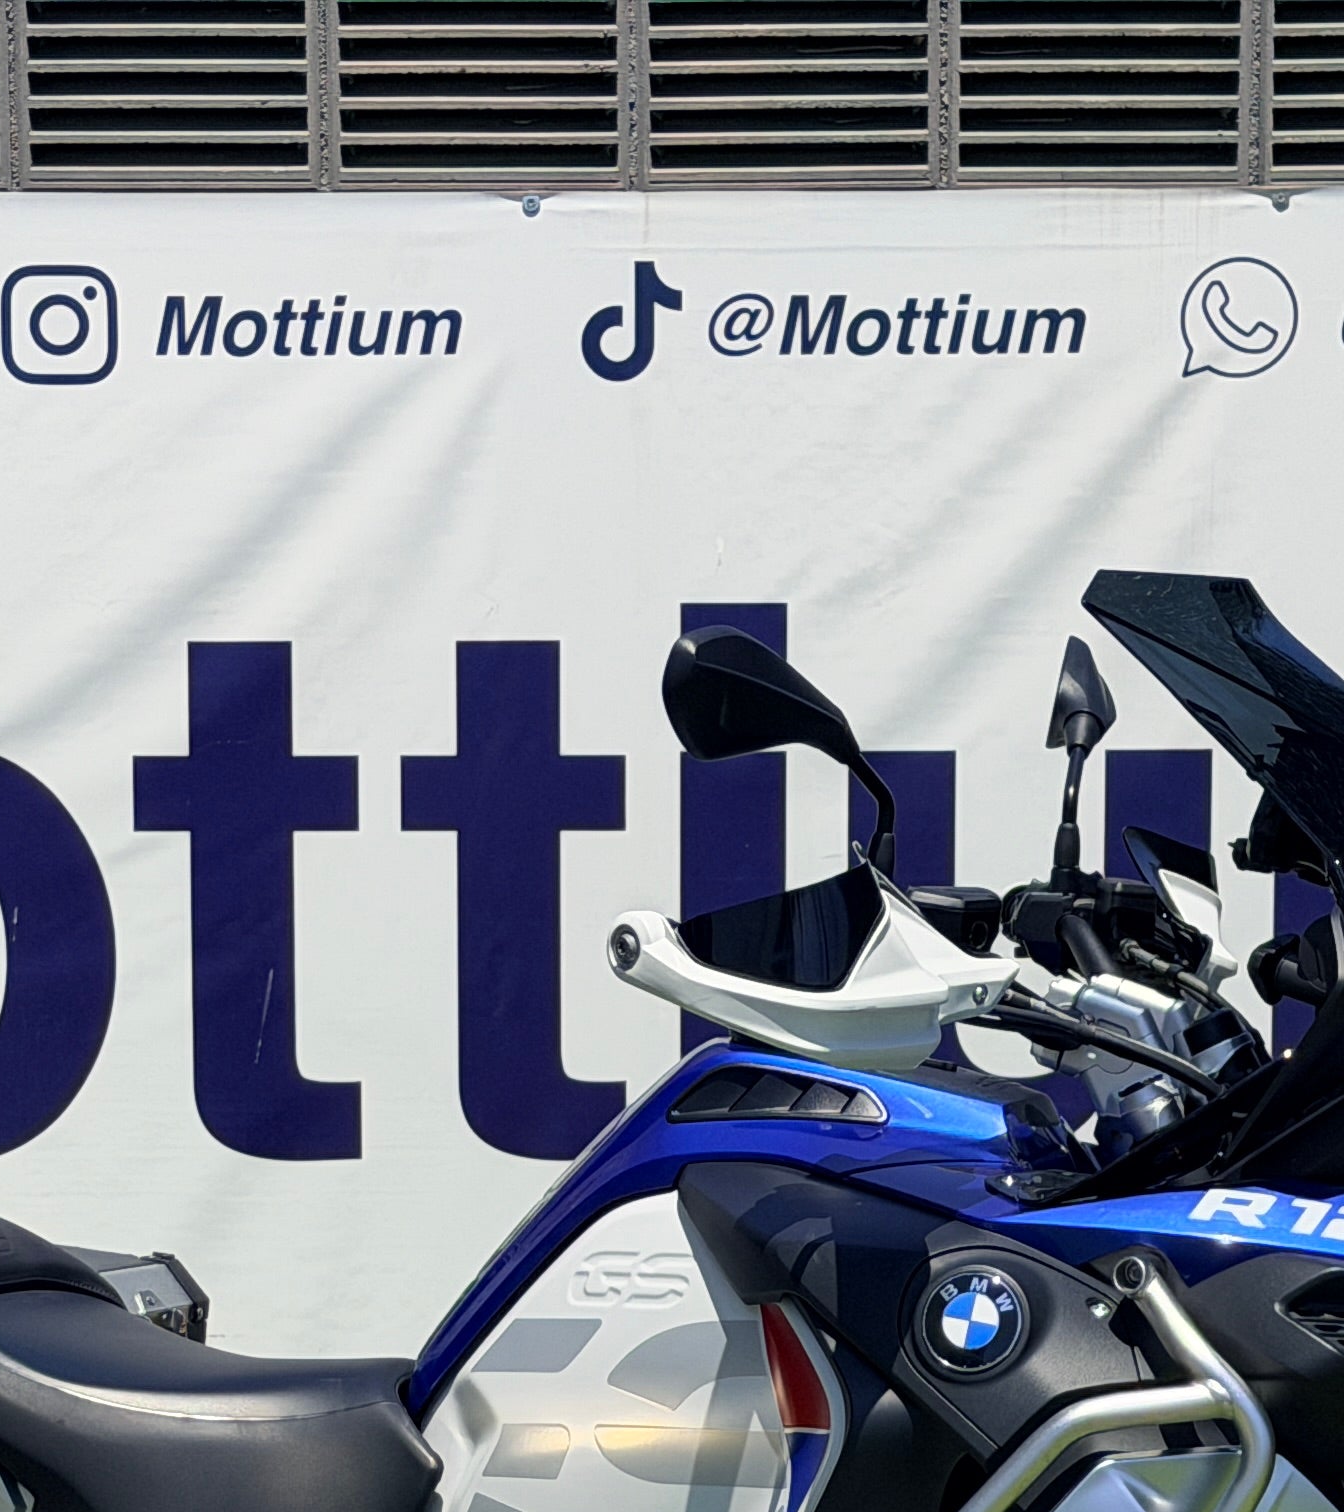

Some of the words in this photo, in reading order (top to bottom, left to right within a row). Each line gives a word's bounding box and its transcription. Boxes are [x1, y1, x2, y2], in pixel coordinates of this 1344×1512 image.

[157, 296, 462, 357] Mottium
[709, 294, 1086, 356] @Mottium
[939, 1276, 1014, 1314] BMW
